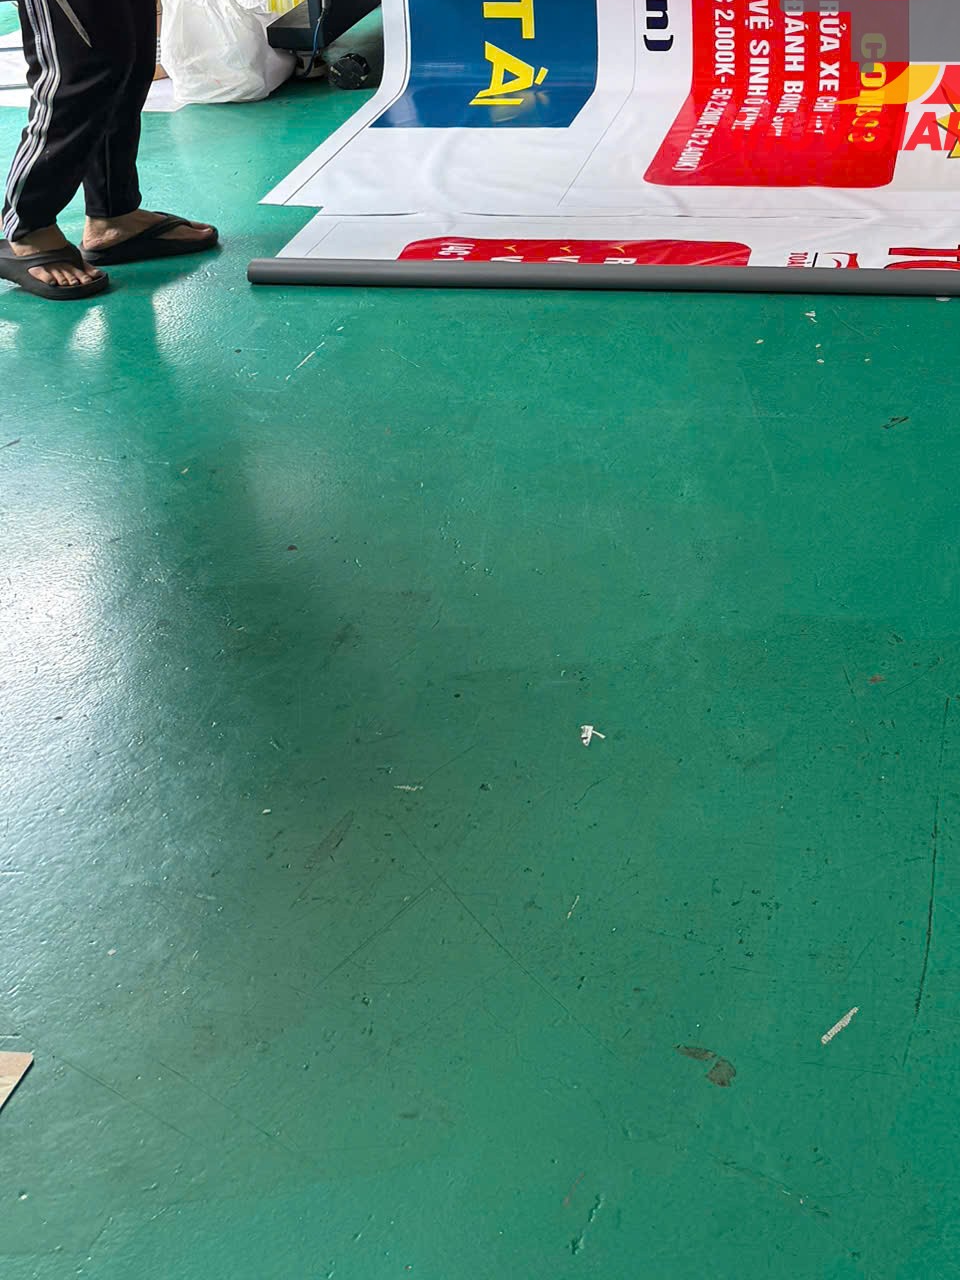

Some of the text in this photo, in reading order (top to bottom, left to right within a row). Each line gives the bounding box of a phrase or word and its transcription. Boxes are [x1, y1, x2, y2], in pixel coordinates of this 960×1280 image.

[744, 0, 774, 31] VỆ
[783, 0, 809, 72] ĐÁNH
[818, 0, 847, 53] RỬA
[747, 38, 771, 96] SINH
[818, 60, 841, 92] XE
